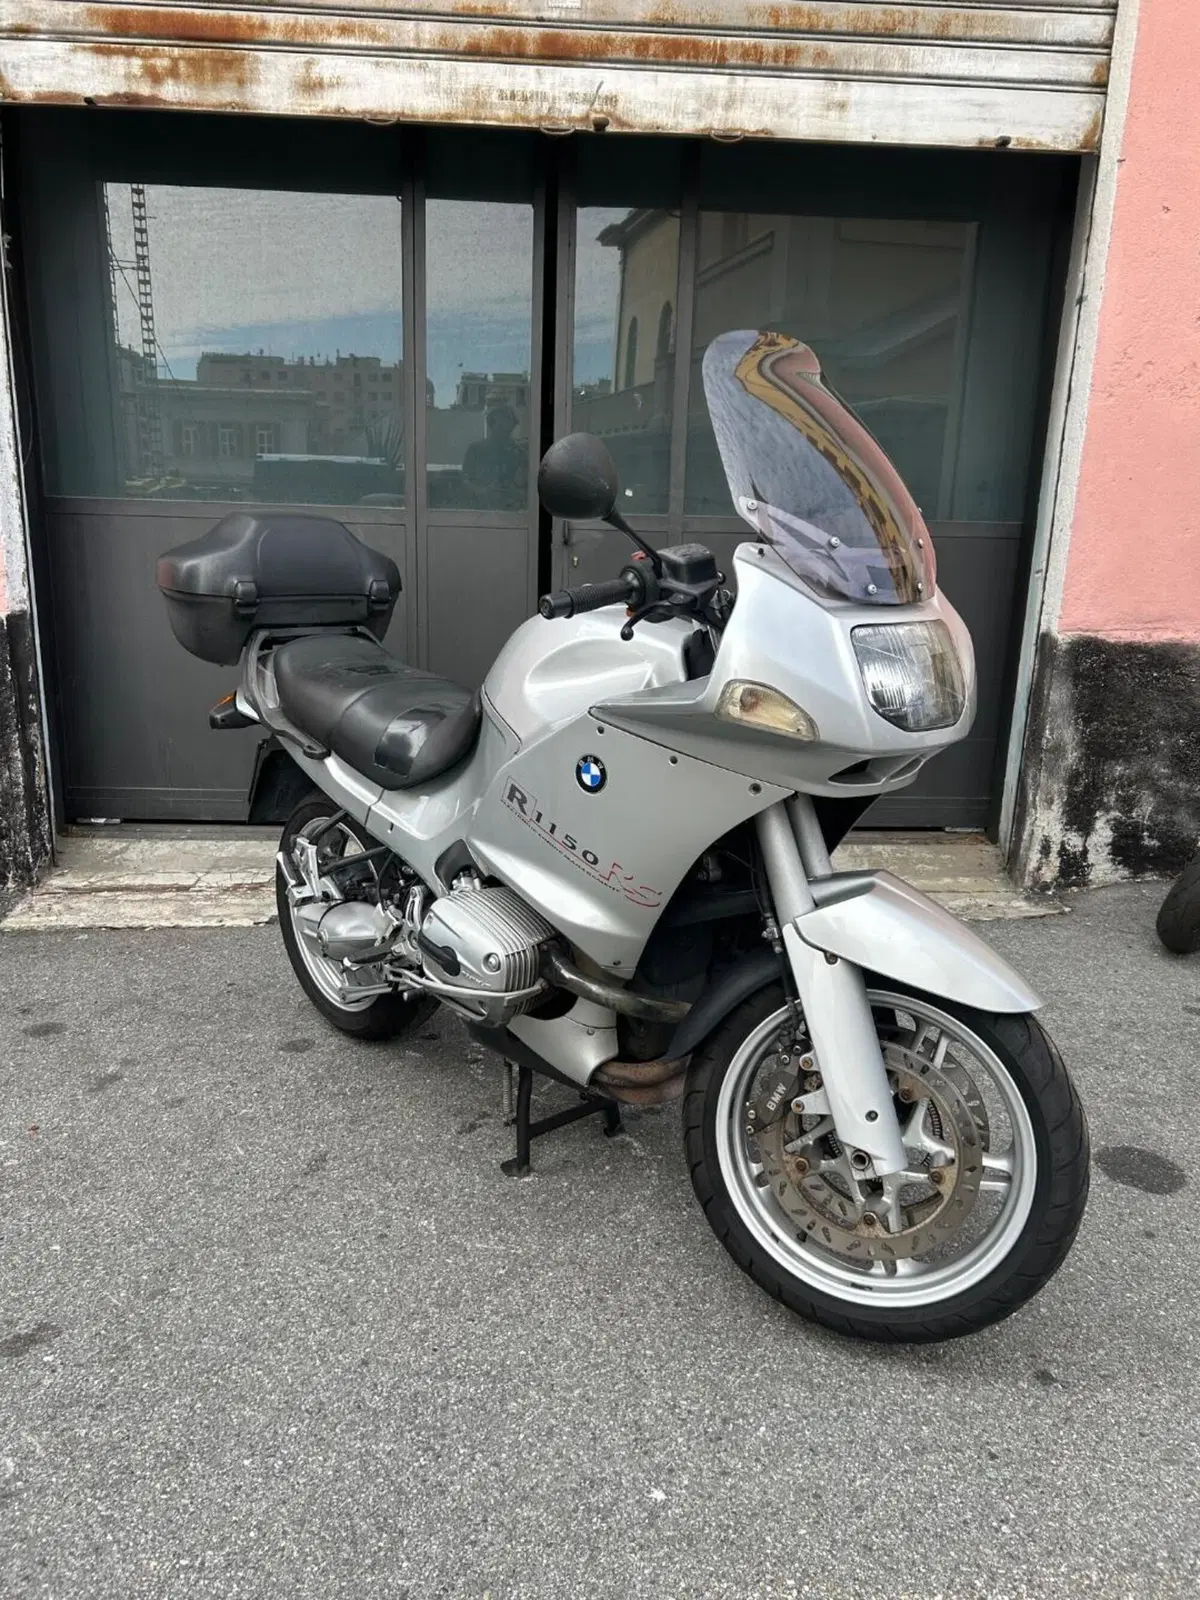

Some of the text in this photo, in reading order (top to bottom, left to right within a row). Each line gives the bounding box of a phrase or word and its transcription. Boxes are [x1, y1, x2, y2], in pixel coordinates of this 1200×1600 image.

[507, 783, 528, 817] R
[535, 809, 600, 866] 1150
[766, 1082, 787, 1111] BMW
